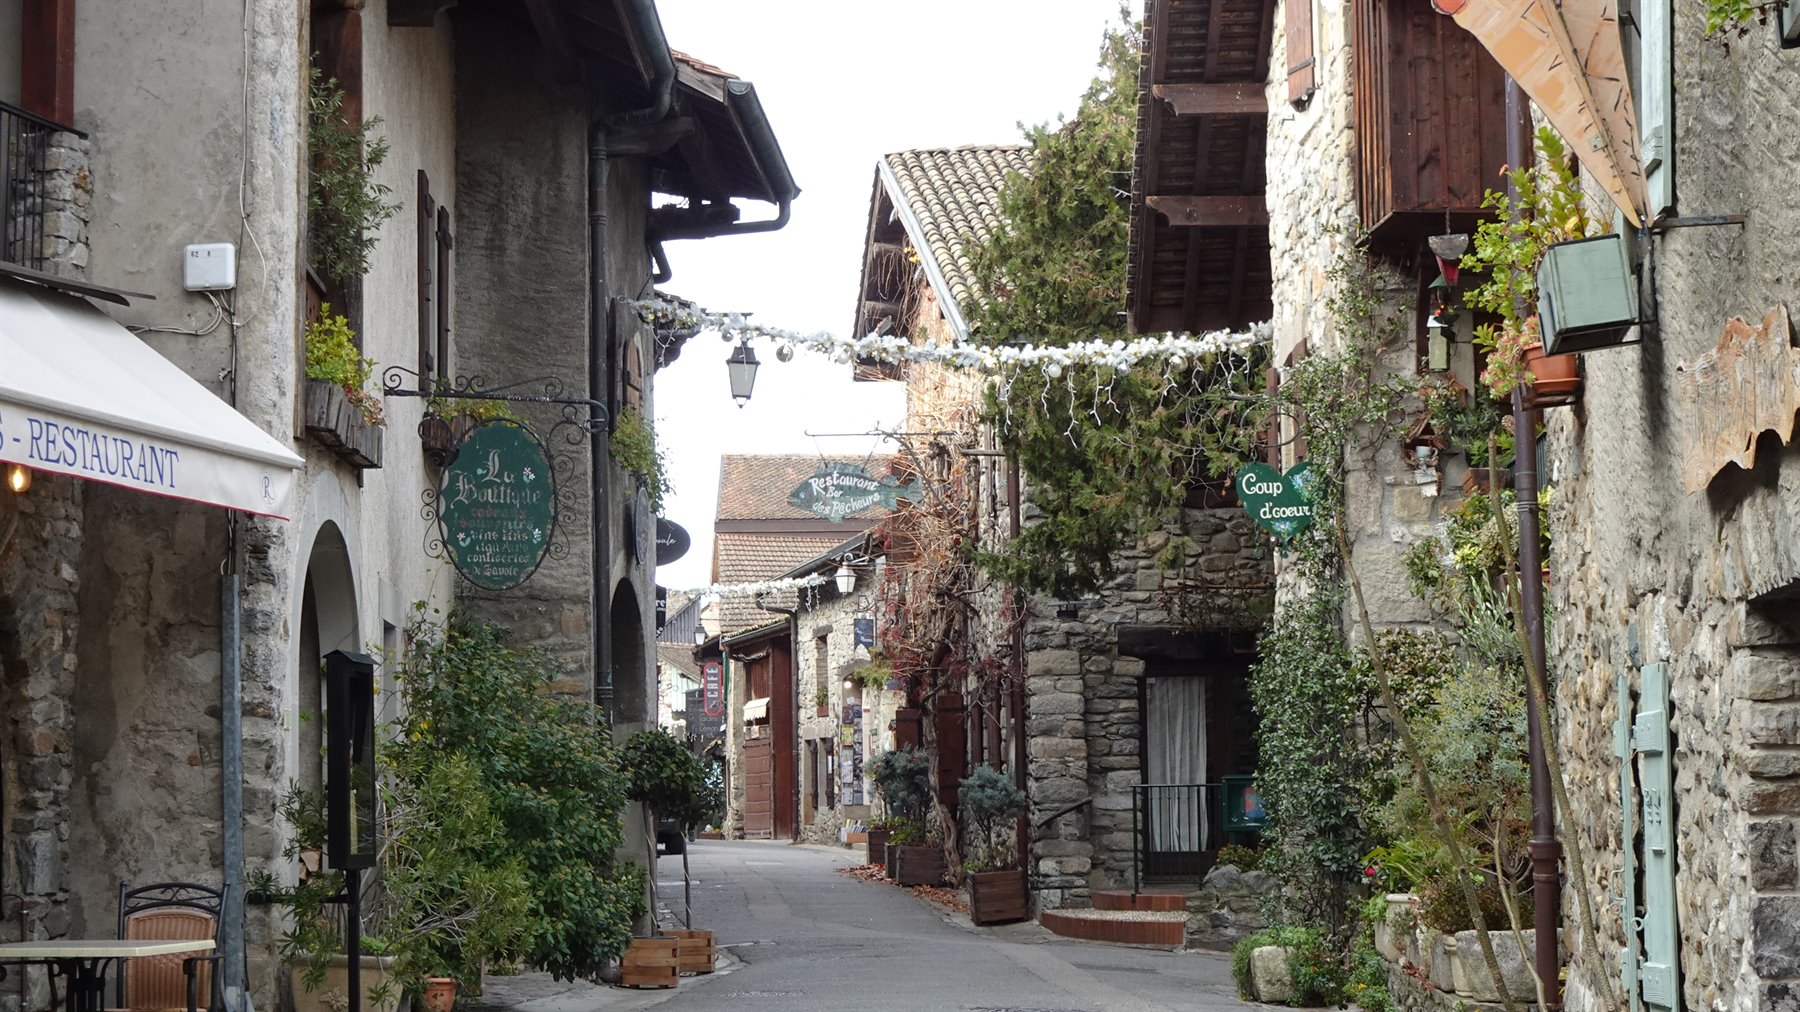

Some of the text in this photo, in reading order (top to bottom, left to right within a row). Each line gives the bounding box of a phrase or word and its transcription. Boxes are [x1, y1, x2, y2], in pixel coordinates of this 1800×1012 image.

[27, 417, 180, 489] RESTAURANT
[481, 448, 514, 483] La
[451, 470, 541, 509] Boutique
[808, 471, 880, 496] Restaurant
[826, 487, 844, 497] Bar
[1242, 473, 1283, 497] Coup
[812, 492, 881, 517] des Pêcheurs
